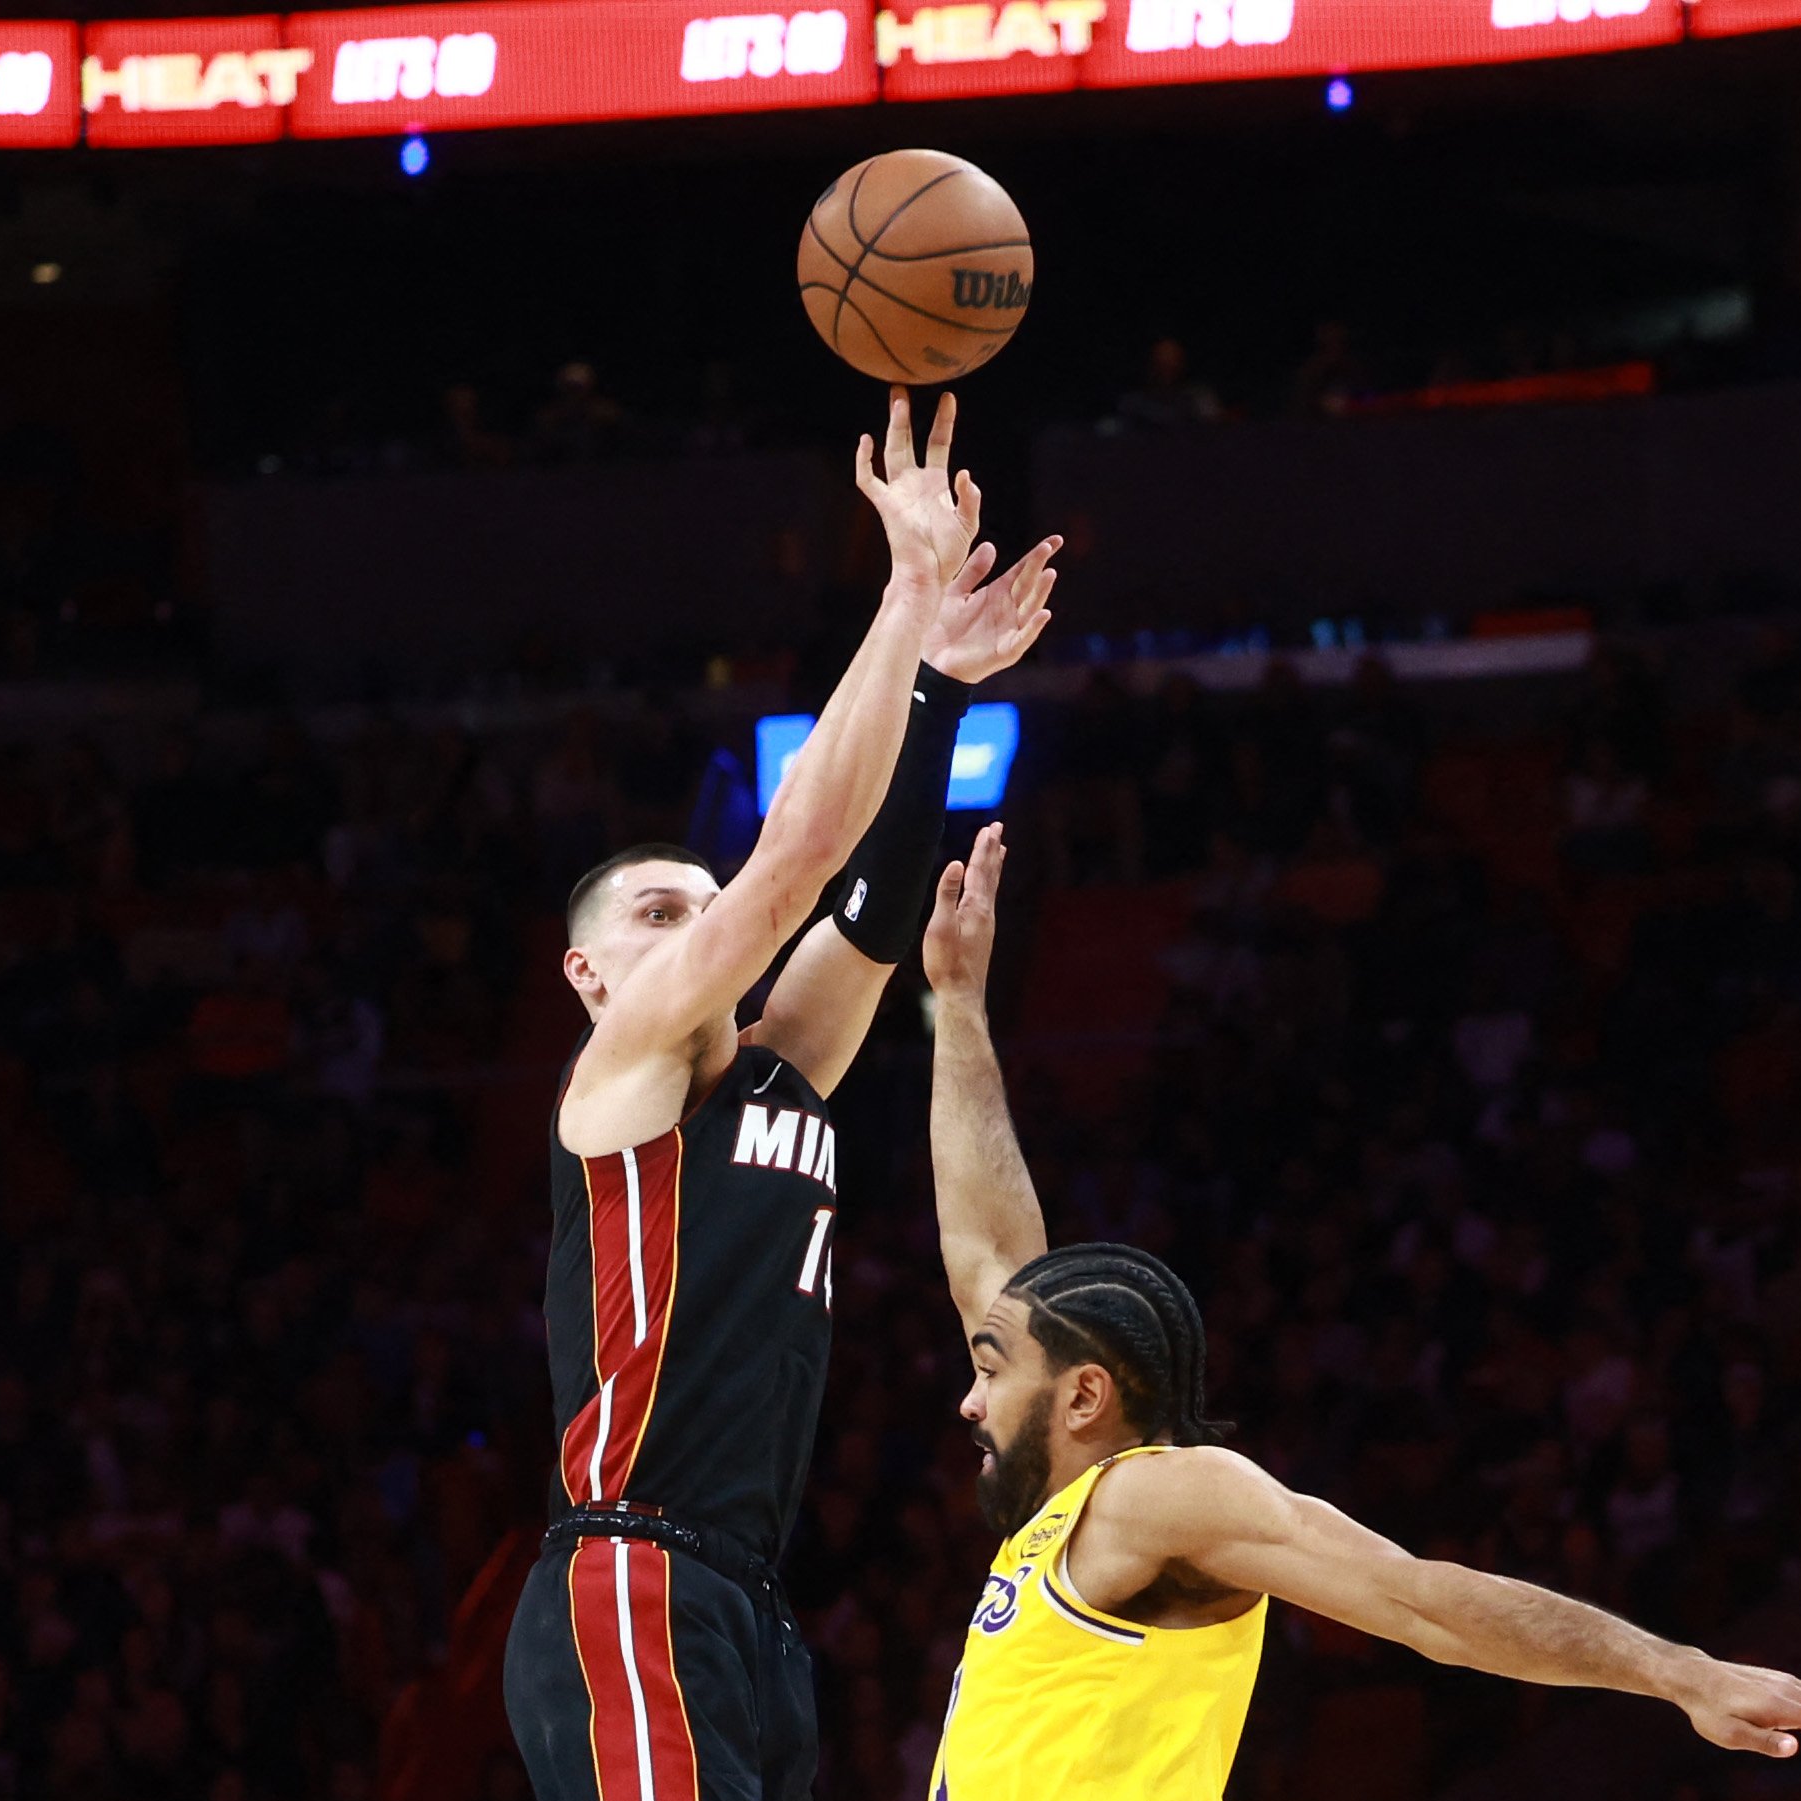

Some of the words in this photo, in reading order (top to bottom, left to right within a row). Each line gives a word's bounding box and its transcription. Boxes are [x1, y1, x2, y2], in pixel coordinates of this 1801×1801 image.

[875, 0, 1105, 66] HEAT
[81, 48, 314, 112] HEAT
[796, 1203, 837, 1312] 1
